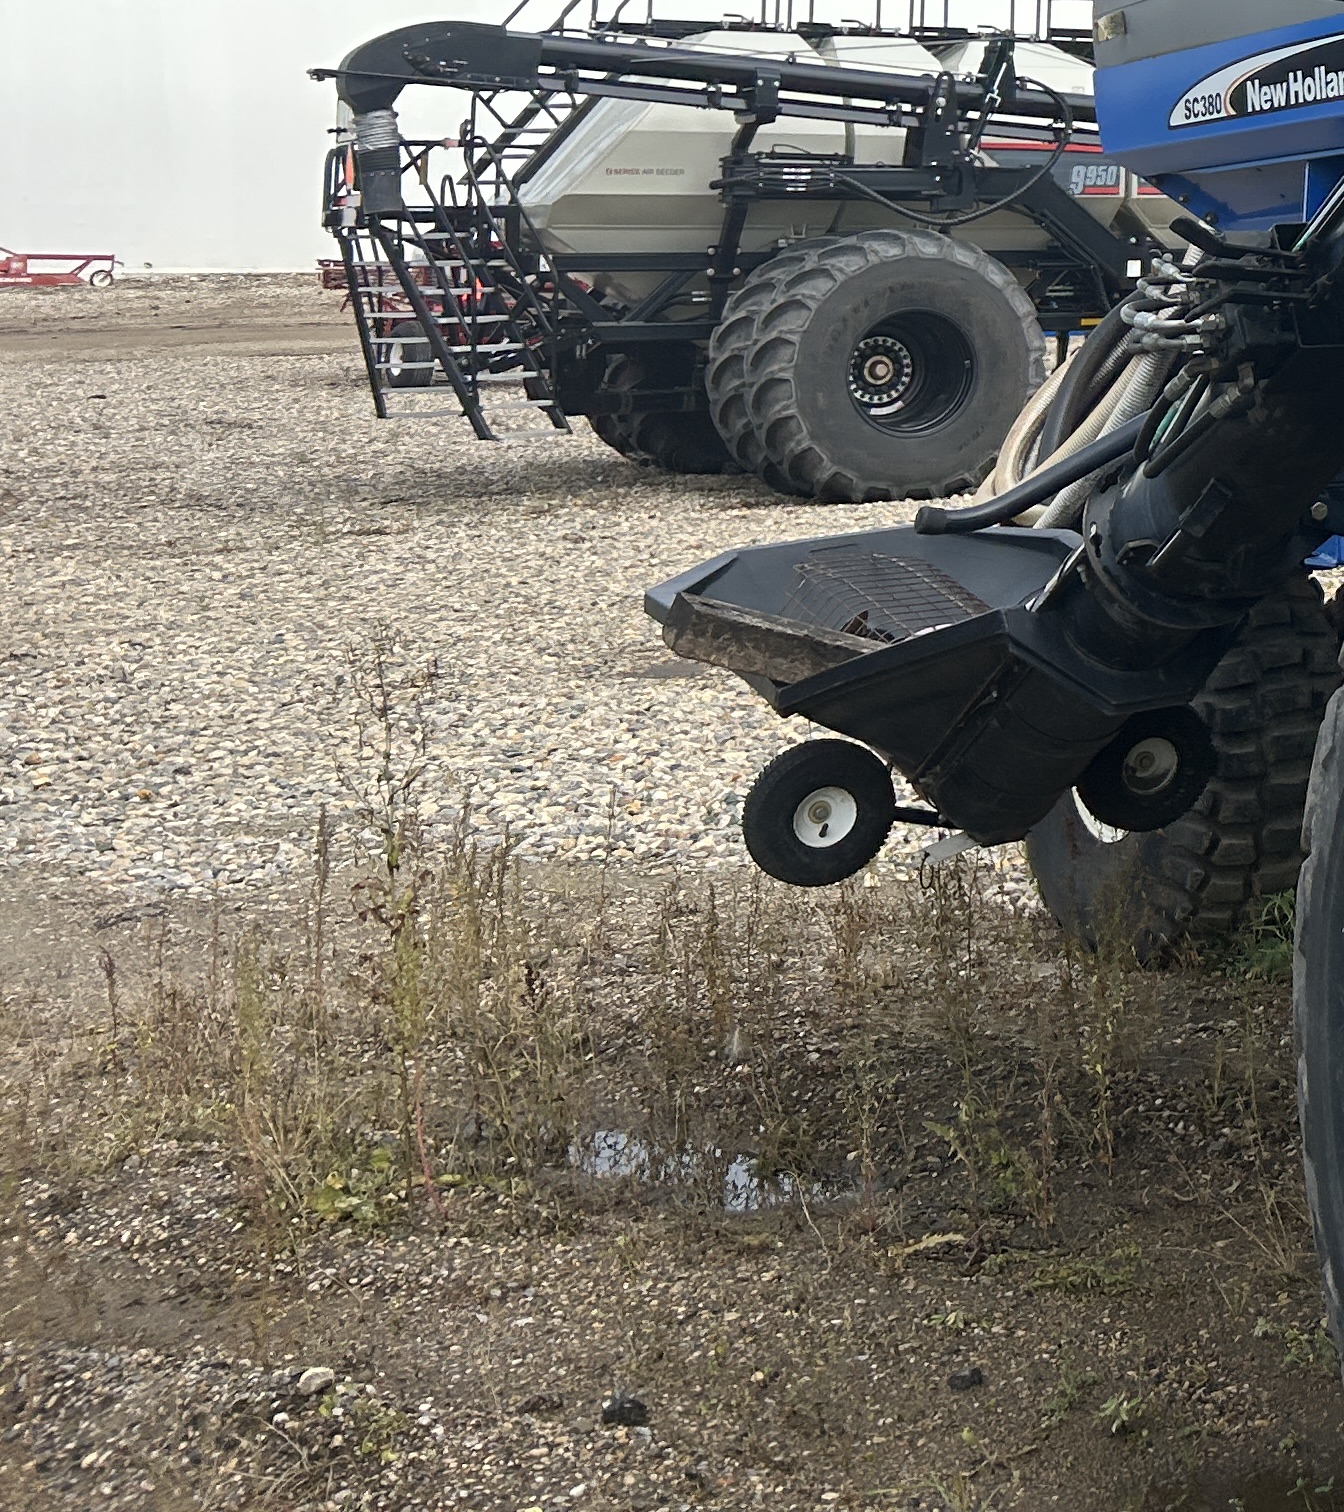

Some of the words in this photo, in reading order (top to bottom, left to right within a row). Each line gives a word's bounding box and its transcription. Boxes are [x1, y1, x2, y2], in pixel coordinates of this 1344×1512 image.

[1184, 92, 1222, 120] SC380
[1245, 79, 1287, 113] New
[1070, 165, 1118, 194] 9950
